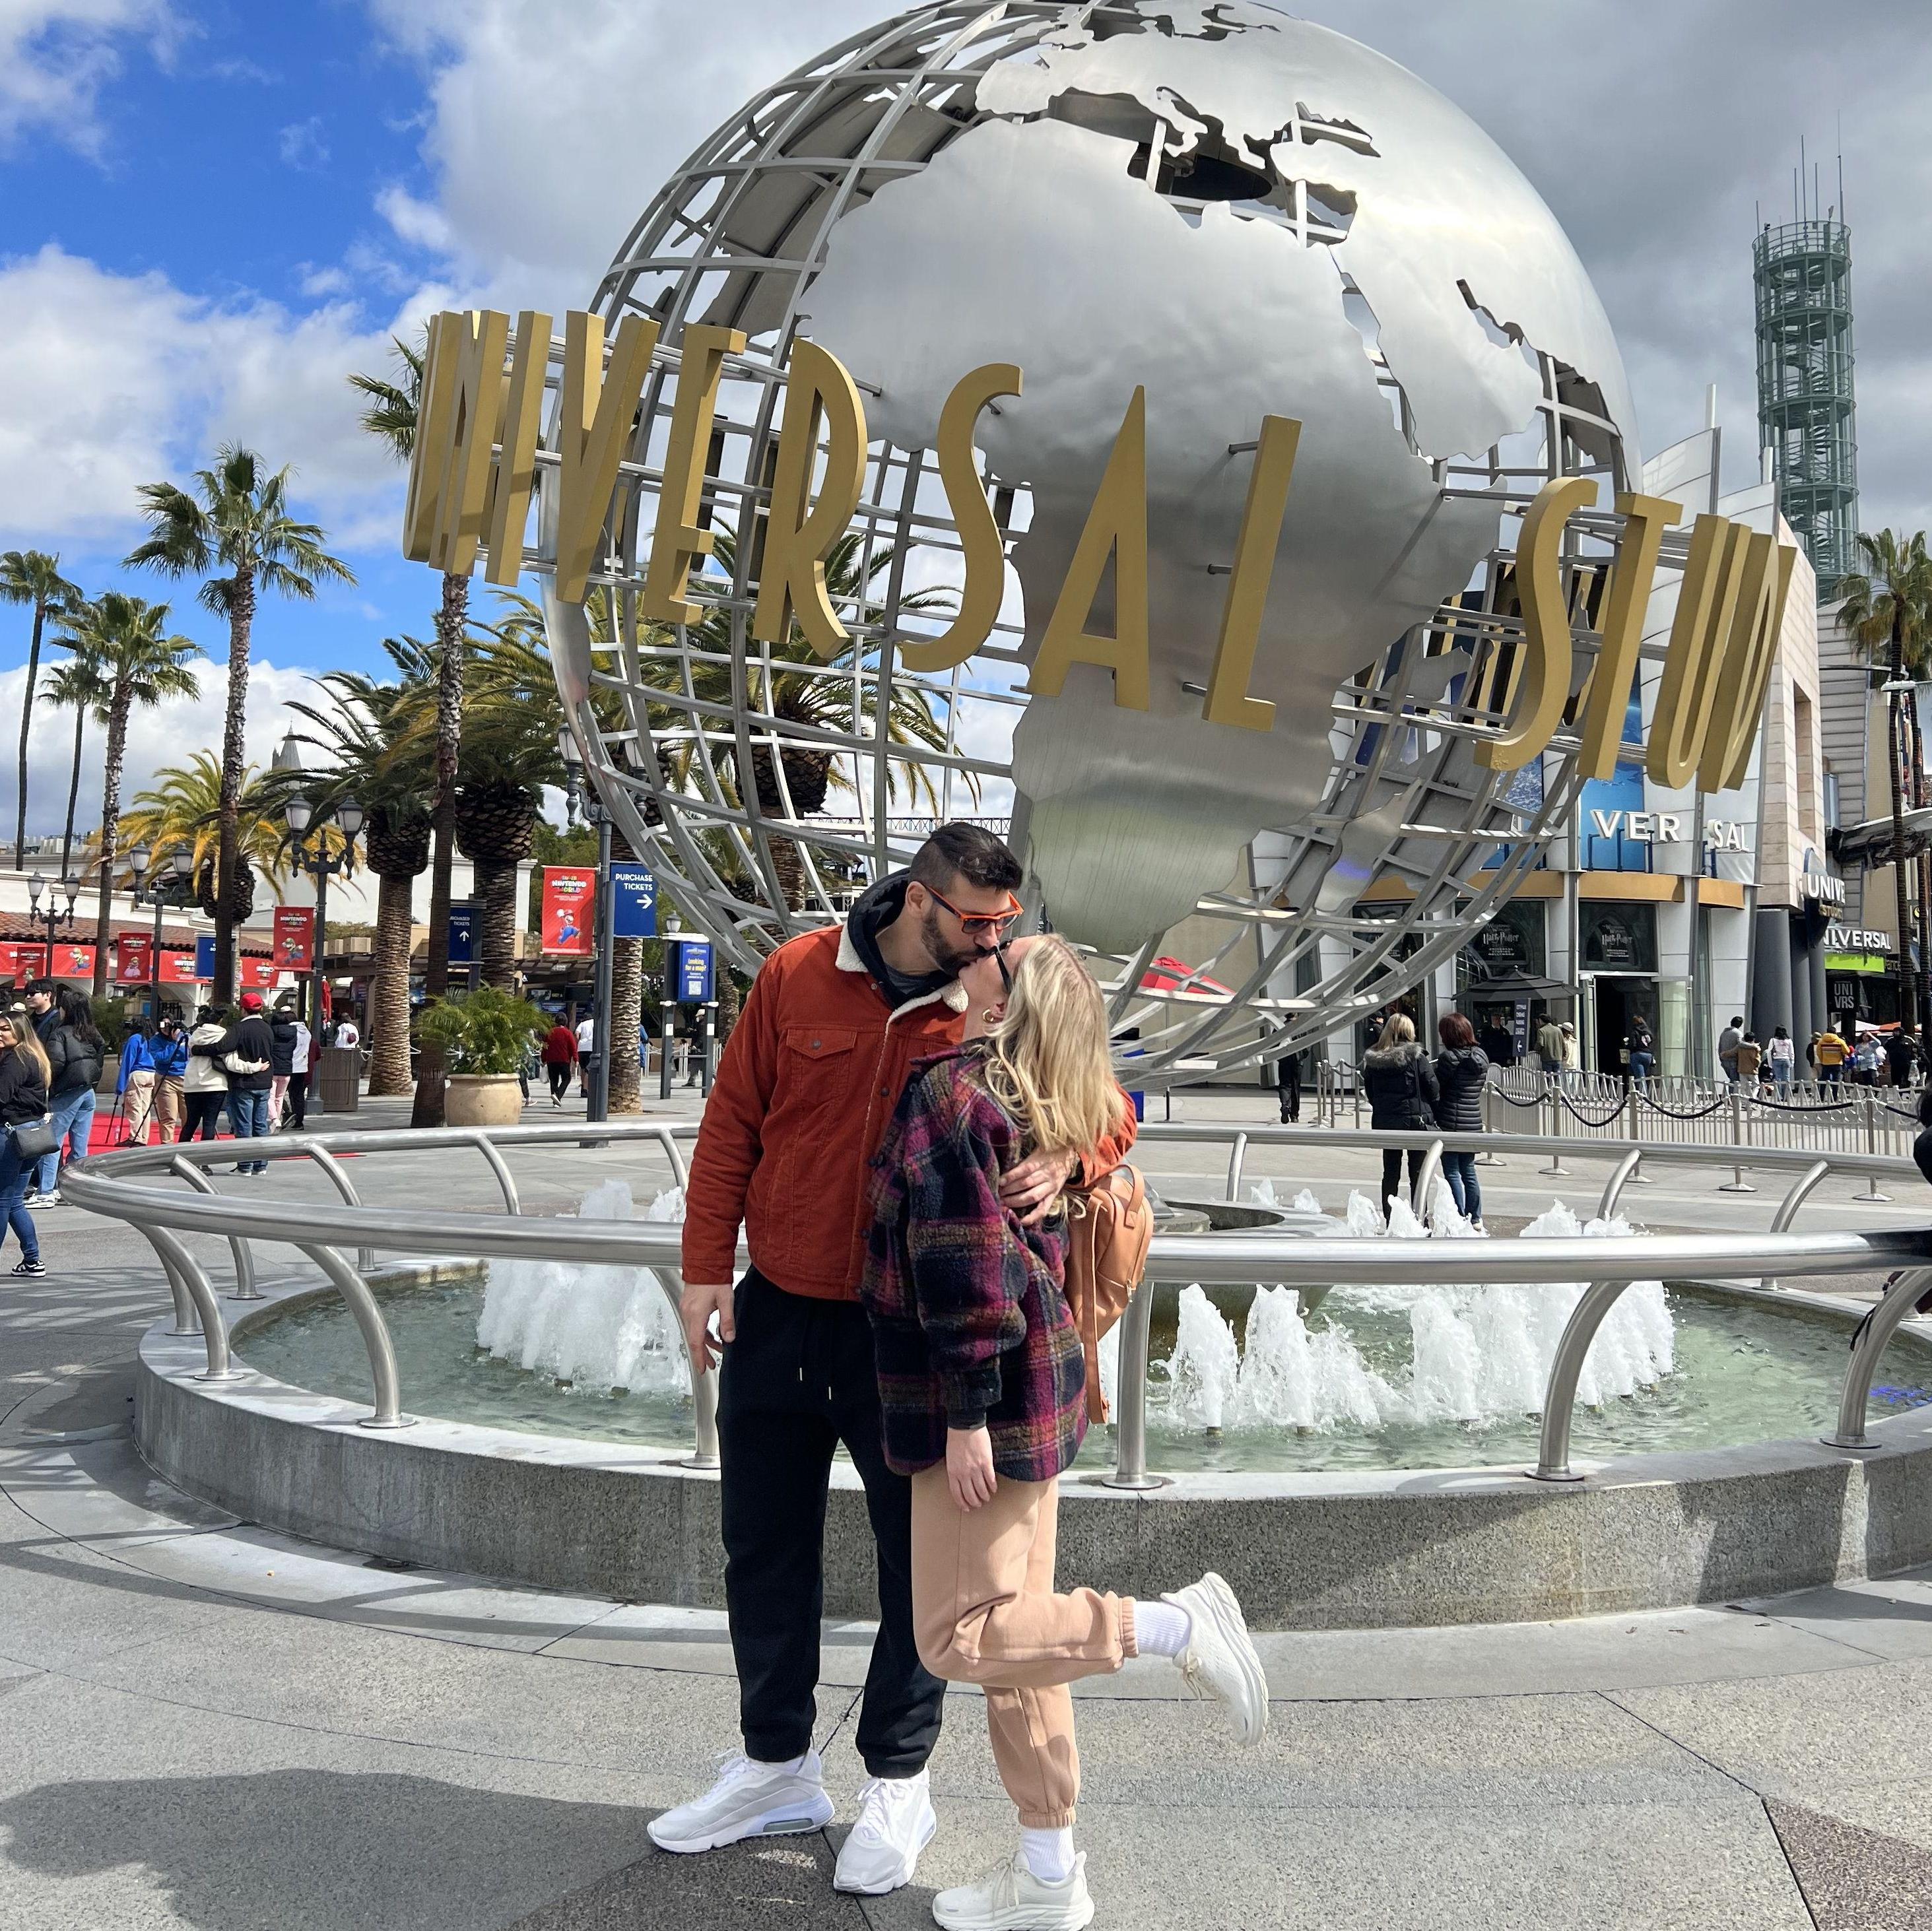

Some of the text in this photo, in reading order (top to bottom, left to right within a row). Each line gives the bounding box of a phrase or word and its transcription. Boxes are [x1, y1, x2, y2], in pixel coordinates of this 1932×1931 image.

[1707, 819, 1750, 852] SAL
[615, 872, 653, 882] PURCHASE
[551, 879, 587, 888] NINTENDO
[624, 882, 653, 891] TICKETS
[1834, 983, 1853, 995] UNI
[1834, 996, 1854, 1008] VRS
